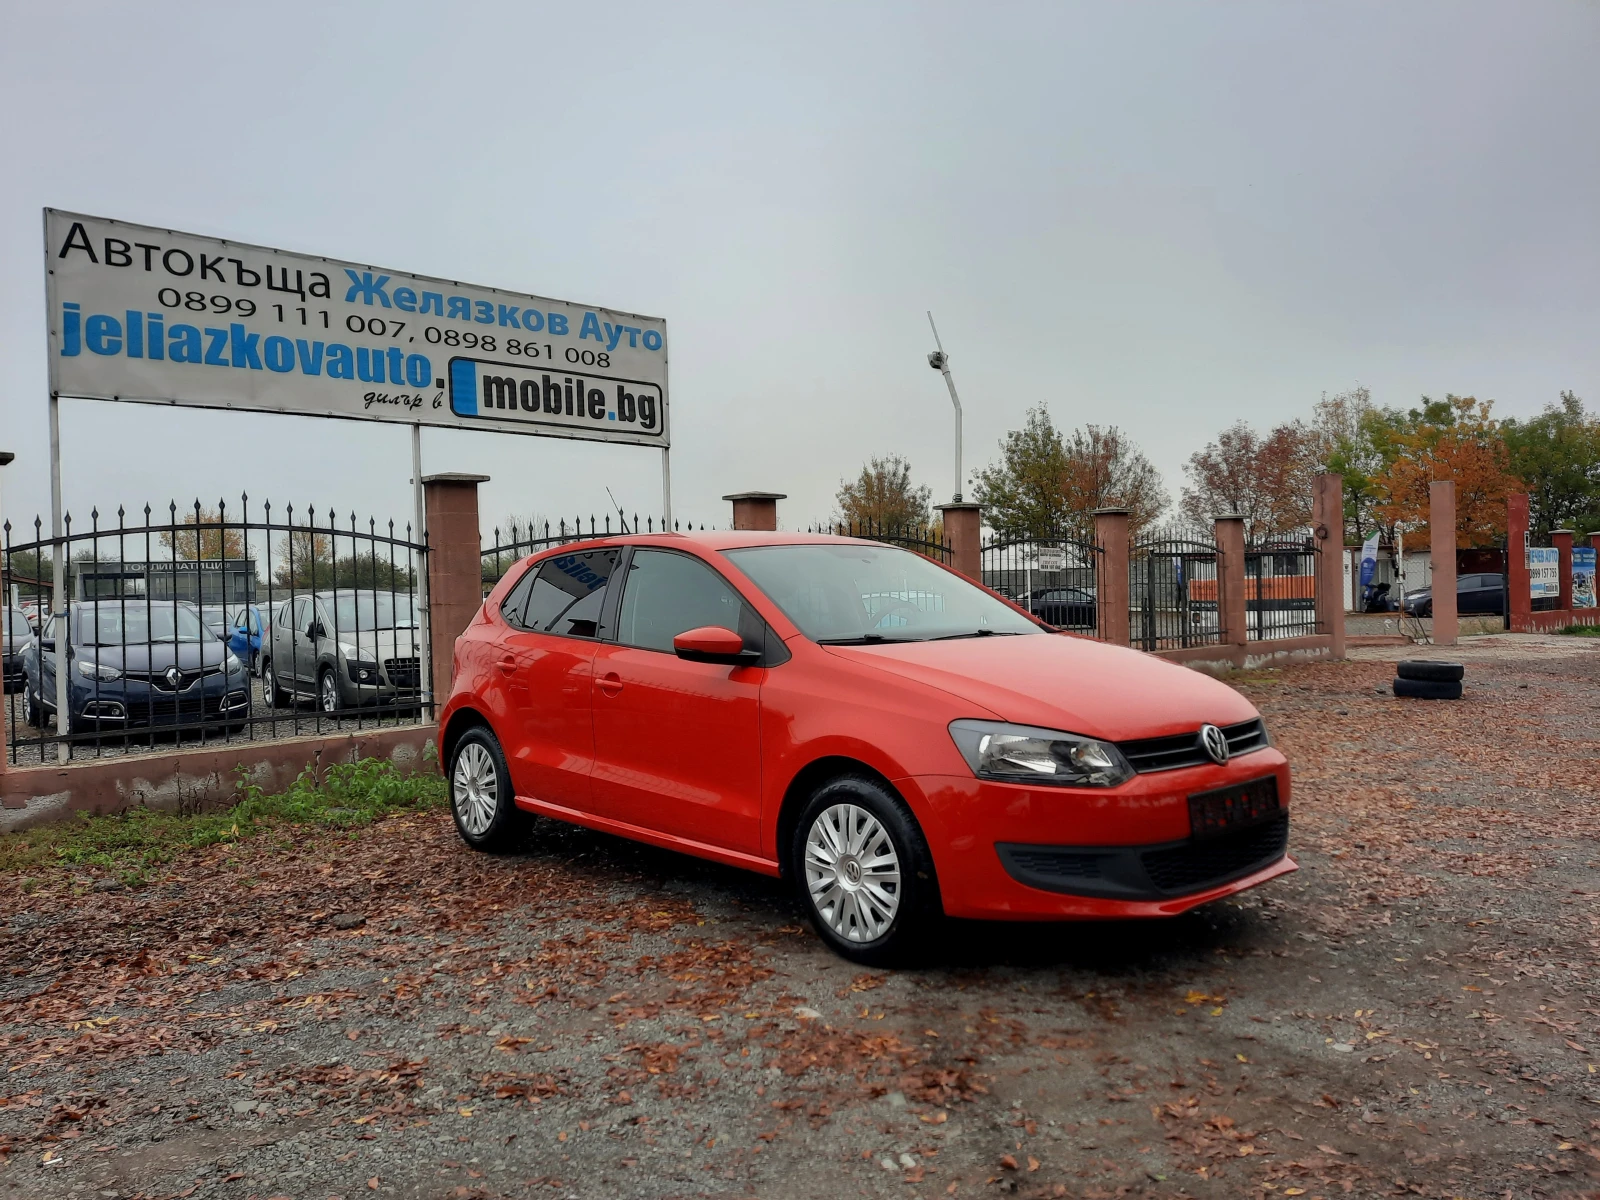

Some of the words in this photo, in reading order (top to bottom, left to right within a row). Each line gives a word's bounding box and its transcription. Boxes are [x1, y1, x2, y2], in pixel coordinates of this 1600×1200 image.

[58, 222, 331, 302] Автокъща
[343, 268, 569, 335] Желязков
[579, 312, 663, 352] Ауто
[158, 287, 257, 317] 0899
[272, 304, 329, 329] 111
[346, 315, 415, 343] 007,
[424, 326, 497, 352] 0898
[506, 338, 552, 360] 861
[565, 347, 611, 368] 008
[483, 374, 656, 429] mobile.bg
